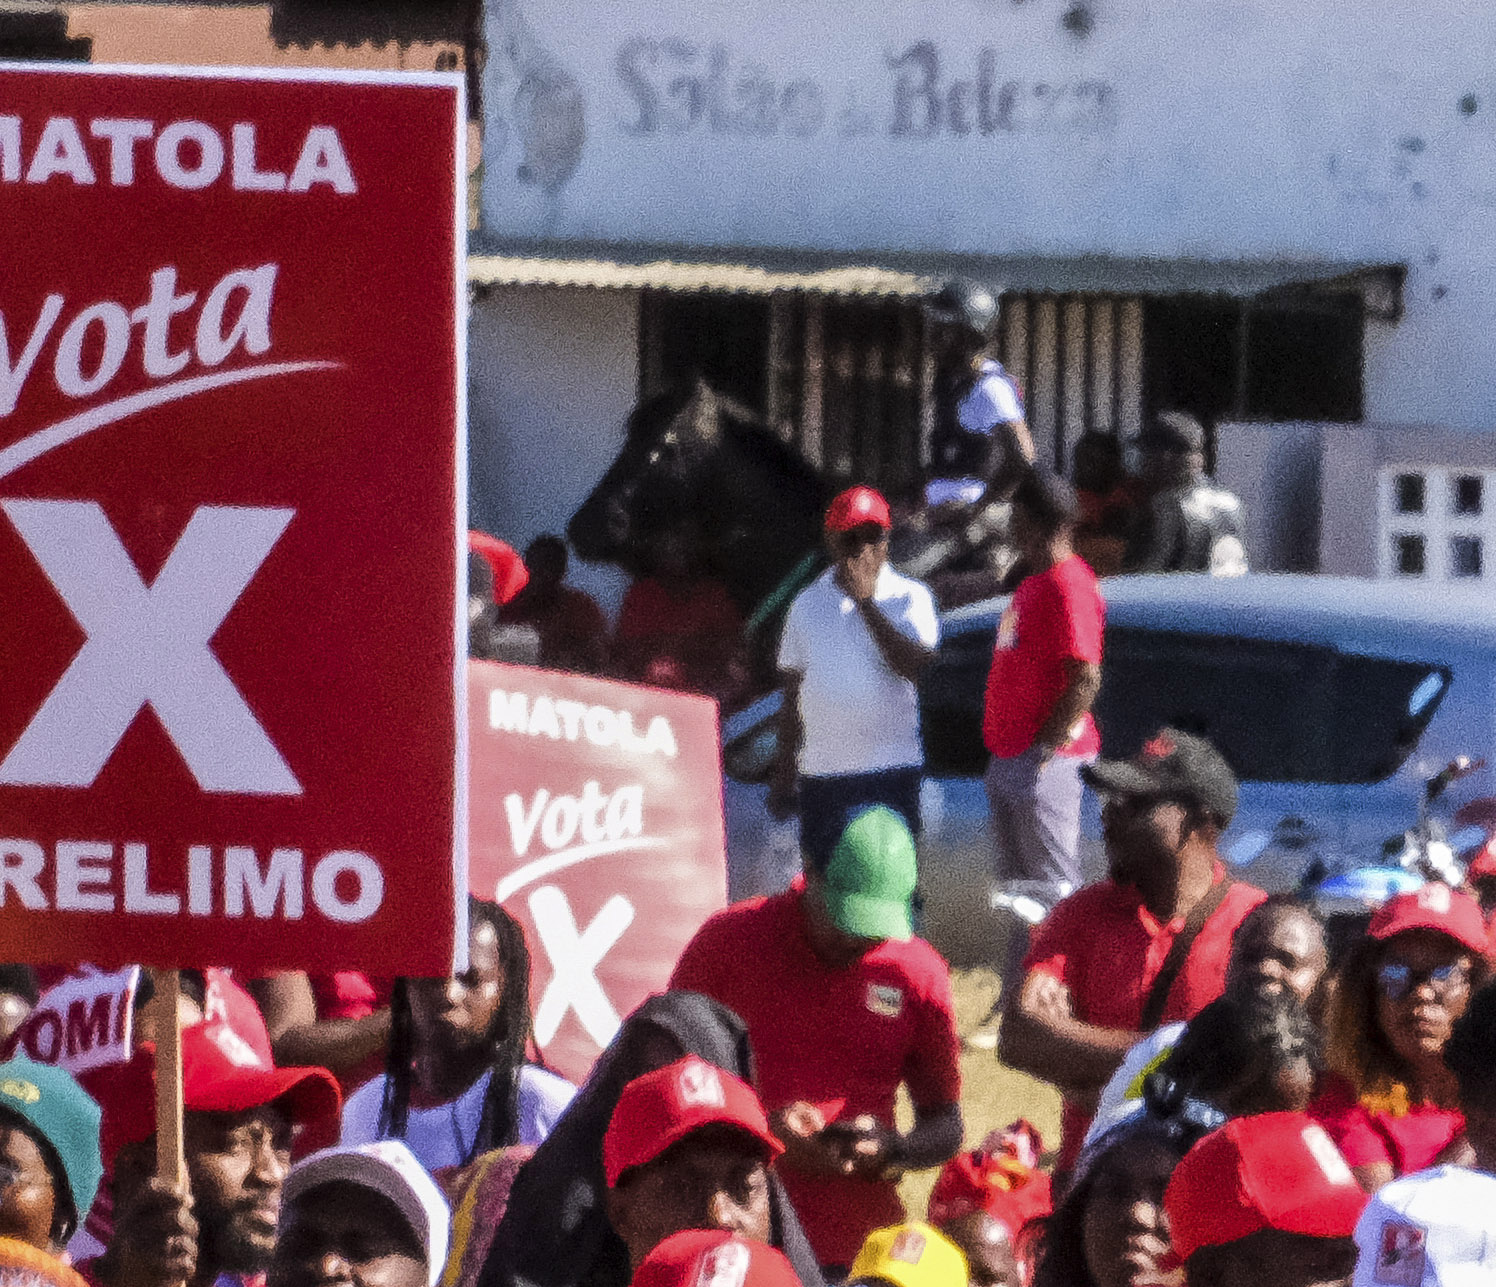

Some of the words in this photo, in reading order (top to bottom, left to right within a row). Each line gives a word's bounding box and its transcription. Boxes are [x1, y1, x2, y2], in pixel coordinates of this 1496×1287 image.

[0, 115, 358, 194] ATOLA
[0, 498, 303, 797] X
[490, 688, 678, 757] MATOLA
[504, 780, 645, 857] Vota
[528, 884, 636, 1049] X
